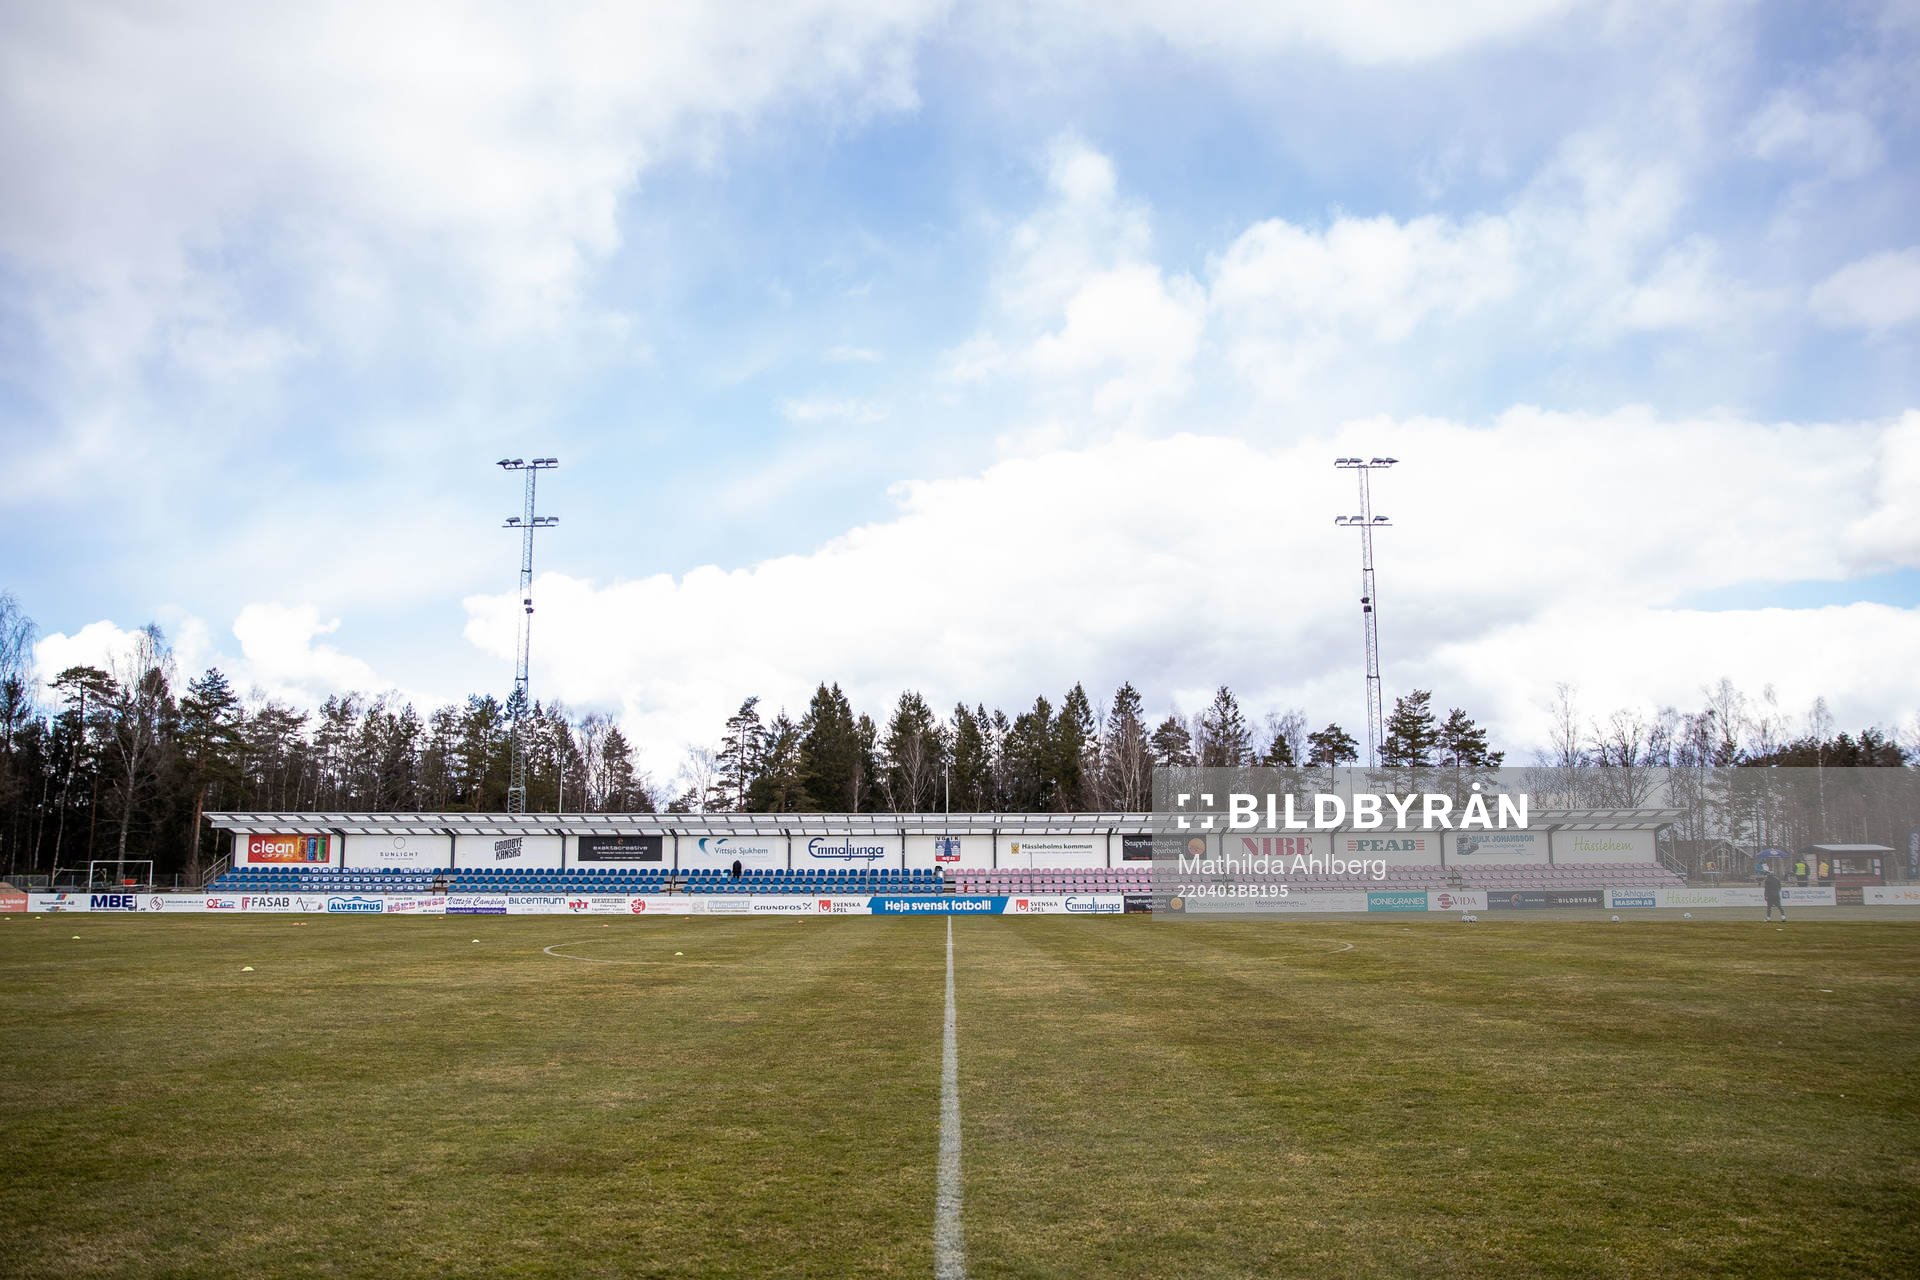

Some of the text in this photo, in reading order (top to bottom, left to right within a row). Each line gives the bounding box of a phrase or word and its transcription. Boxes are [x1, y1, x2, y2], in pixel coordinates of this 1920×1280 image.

[251, 840, 294, 853] clean
[495, 837, 523, 851] GOODBYE
[808, 838, 884, 862] Emmaljunga
[1241, 837, 1313, 856] NIBE
[1356, 839, 1416, 851] PEAB
[496, 847, 521, 860] KANSAS
[1452, 896, 1477, 905] VIDA
[1624, 890, 1655, 899] Ahlquist
[91, 895, 133, 908] MBE
[252, 897, 290, 907] FASAB
[473, 897, 505, 907] Camping
[885, 900, 991, 912] Heja svensk fotboll!
[1065, 897, 1120, 914] Emmaljunga
